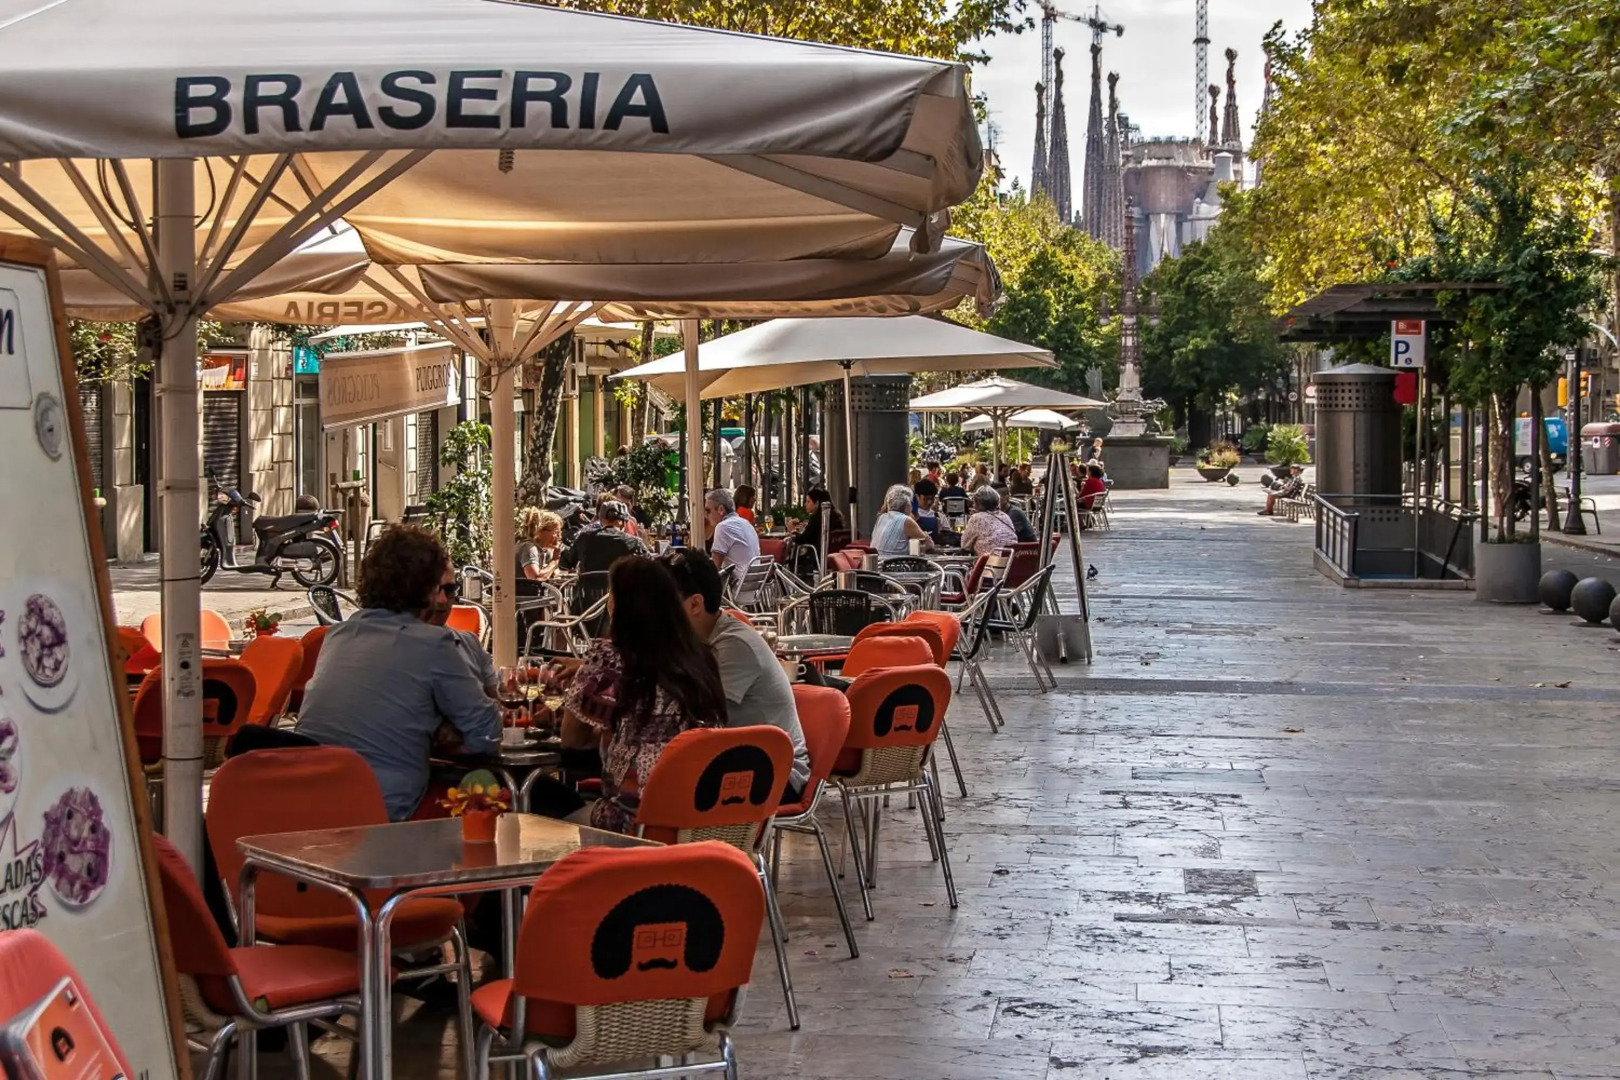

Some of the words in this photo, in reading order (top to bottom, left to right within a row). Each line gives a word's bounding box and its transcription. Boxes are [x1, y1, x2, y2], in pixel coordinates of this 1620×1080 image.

[176, 70, 669, 138] BRASERIA
[1394, 340, 1410, 366] P
[0, 893, 39, 931] SCAS
